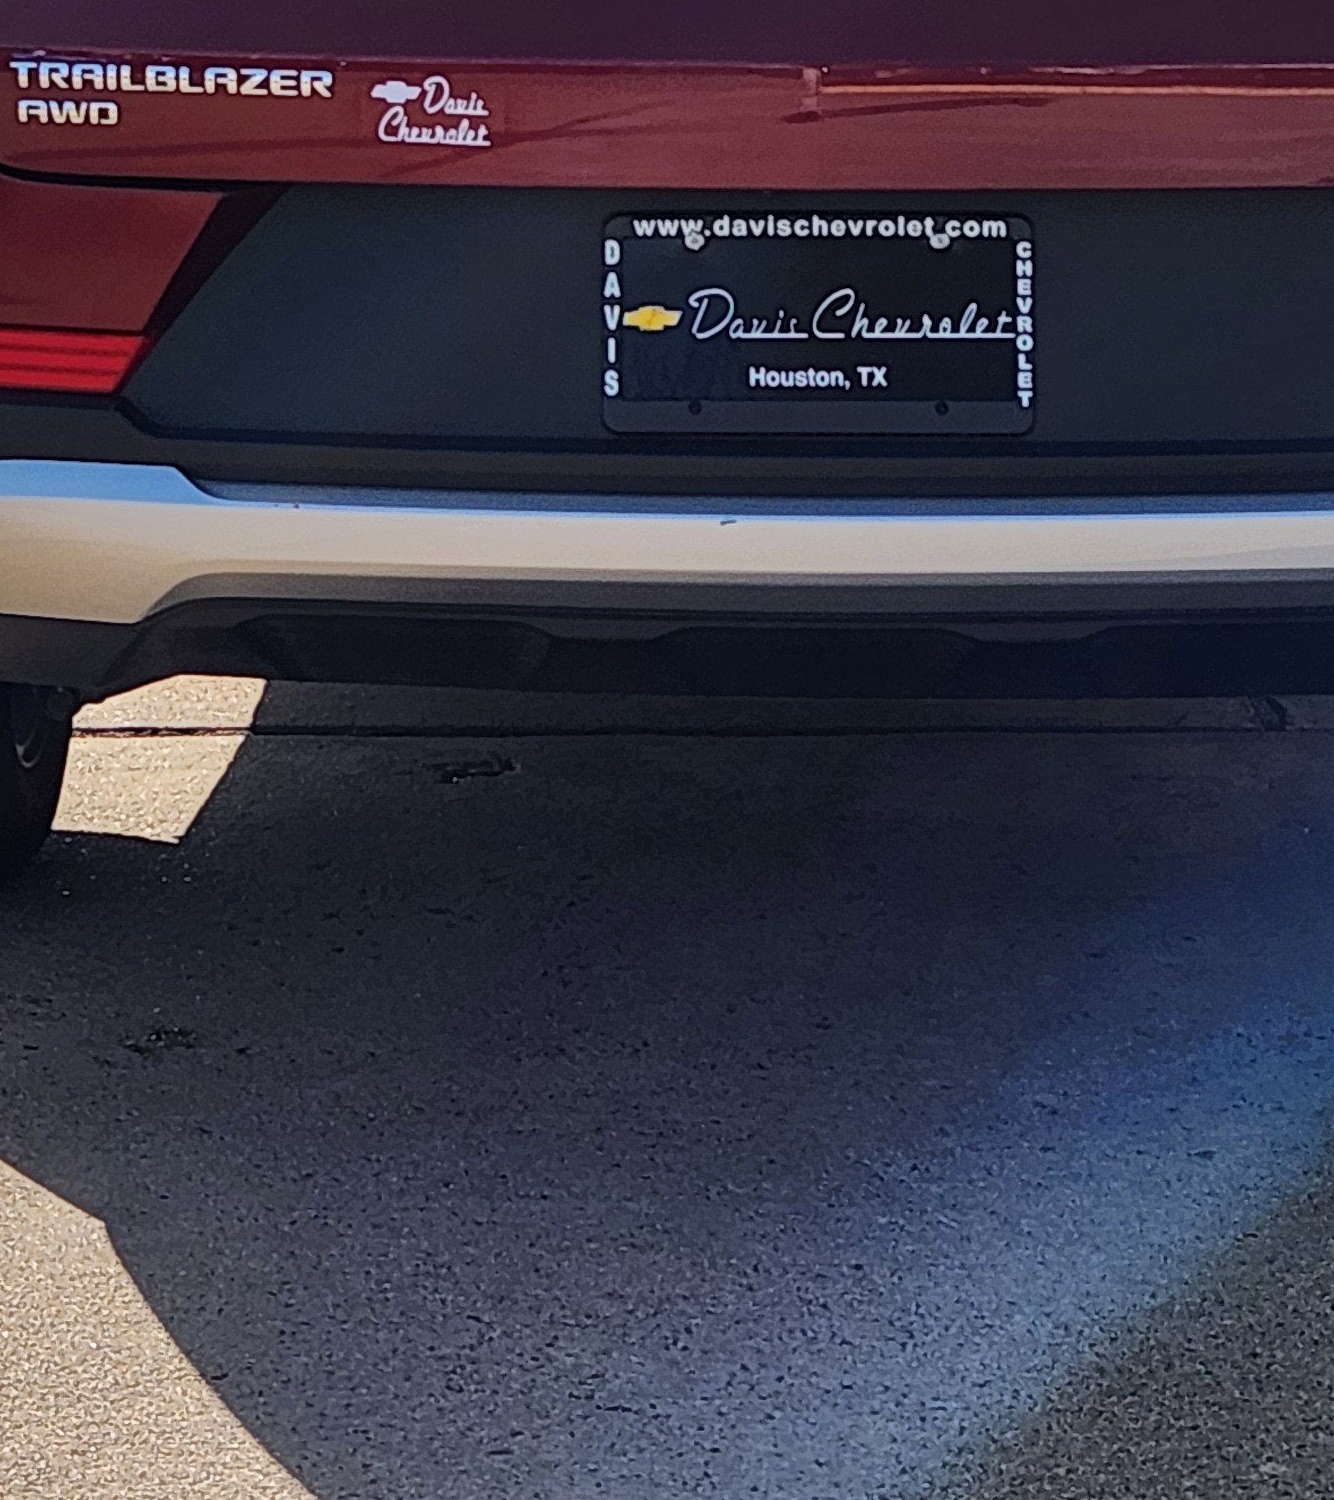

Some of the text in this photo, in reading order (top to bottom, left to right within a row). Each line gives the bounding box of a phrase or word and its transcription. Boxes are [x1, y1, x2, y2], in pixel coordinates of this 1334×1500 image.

[9, 61, 333, 98] TRAILBLAZER
[423, 75, 489, 116] Davis
[18, 100, 118, 125] AWD
[378, 105, 491, 147] Chevrolet
[632, 214, 1007, 238] www.davischevroletcom
[603, 239, 621, 396] DAVIS
[688, 288, 1016, 340] Davis Chevrolet
[1016, 241, 1034, 408] CHEVROLET
[749, 366, 888, 390] Houston, TX
